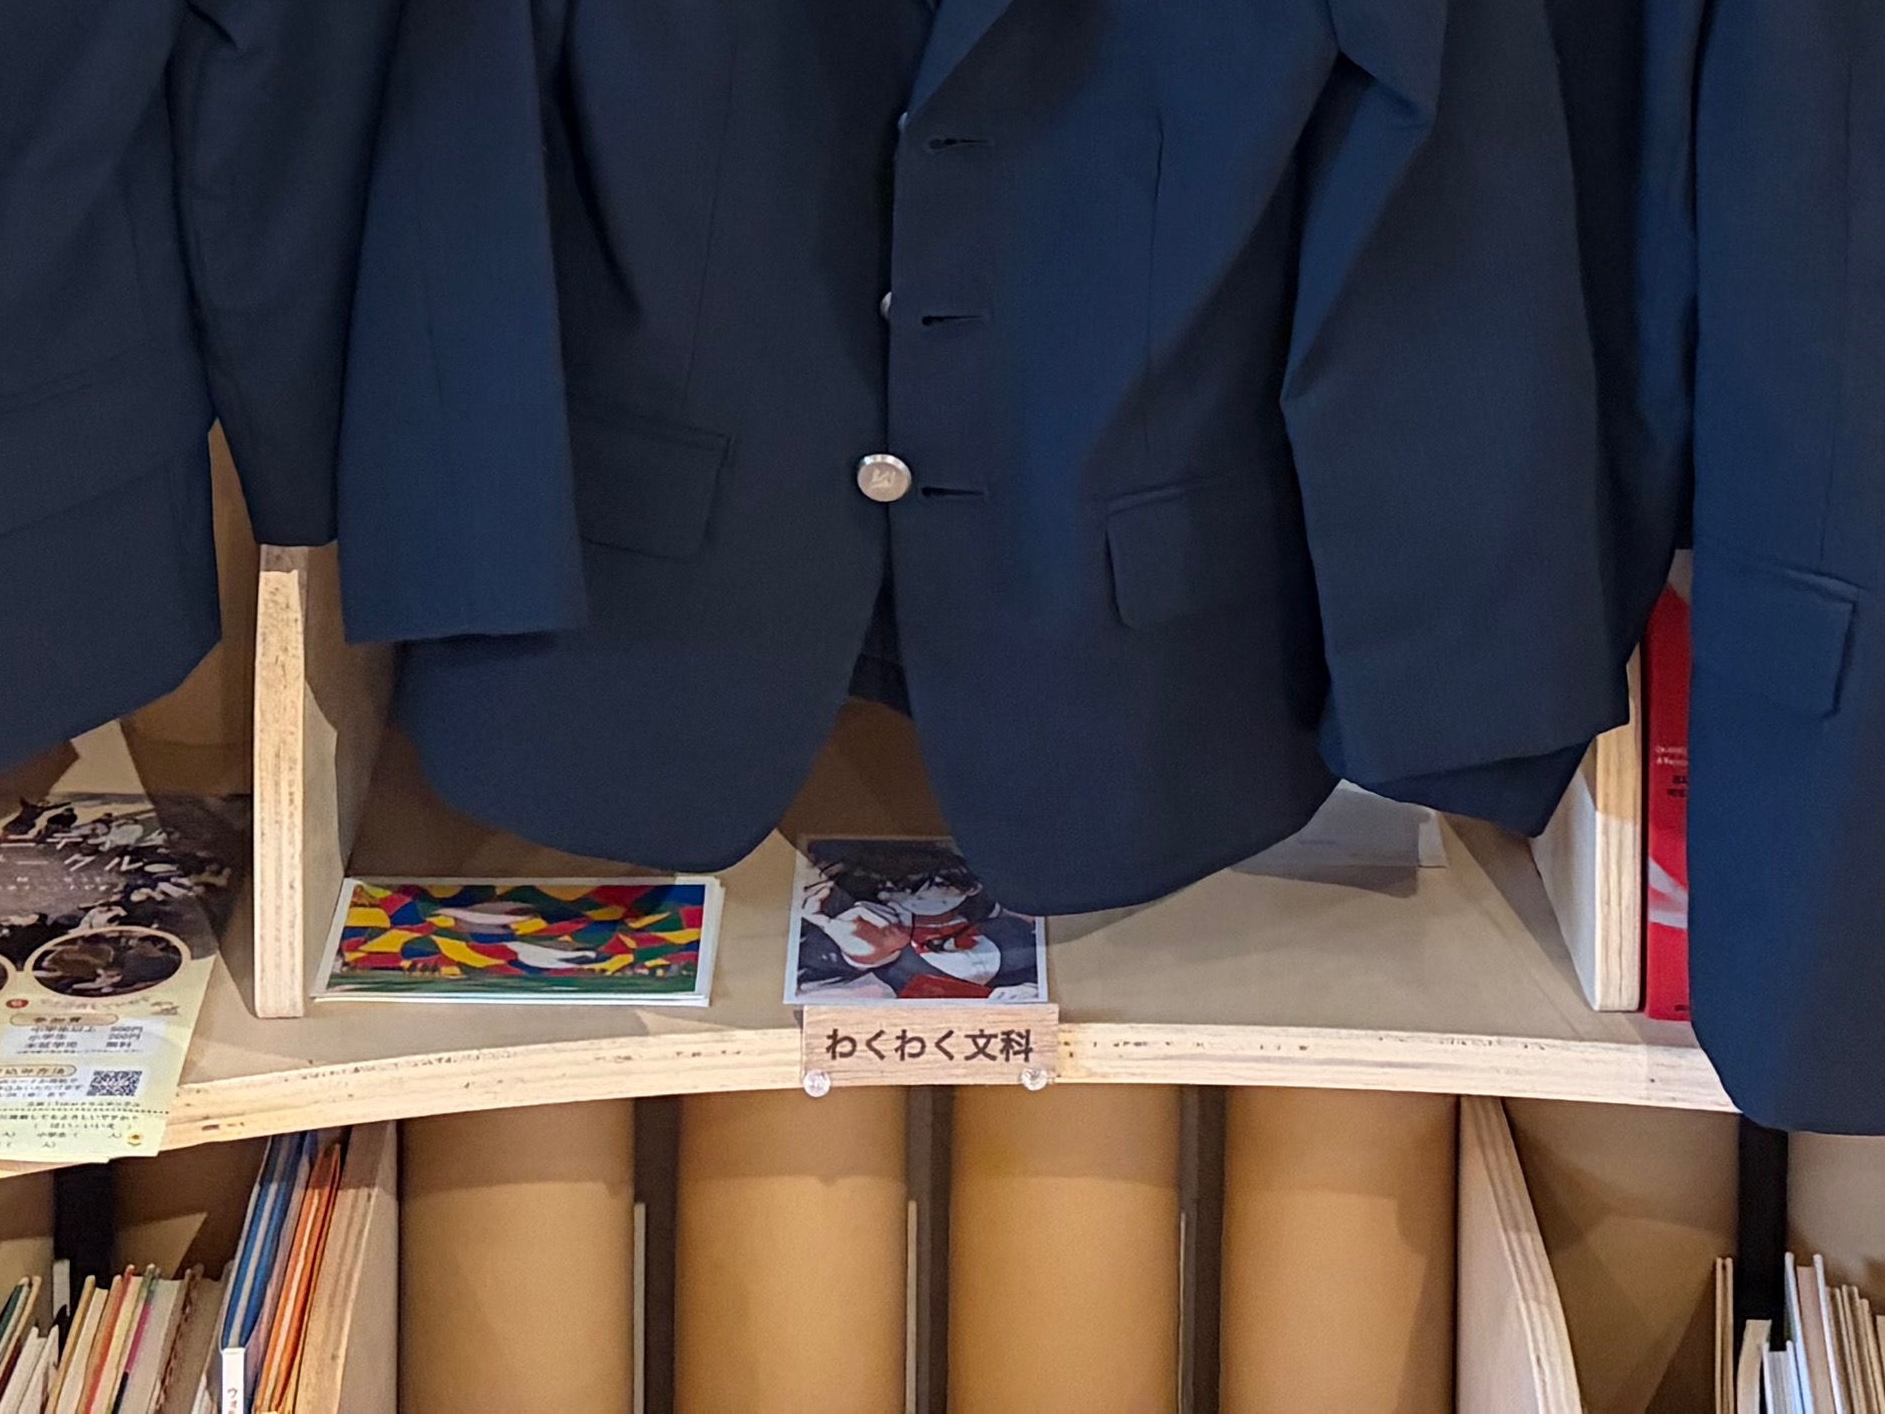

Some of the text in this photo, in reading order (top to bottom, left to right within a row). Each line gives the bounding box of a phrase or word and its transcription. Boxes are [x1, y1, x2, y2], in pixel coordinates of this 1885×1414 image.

[825, 1028, 1035, 1065] わくわく文科
